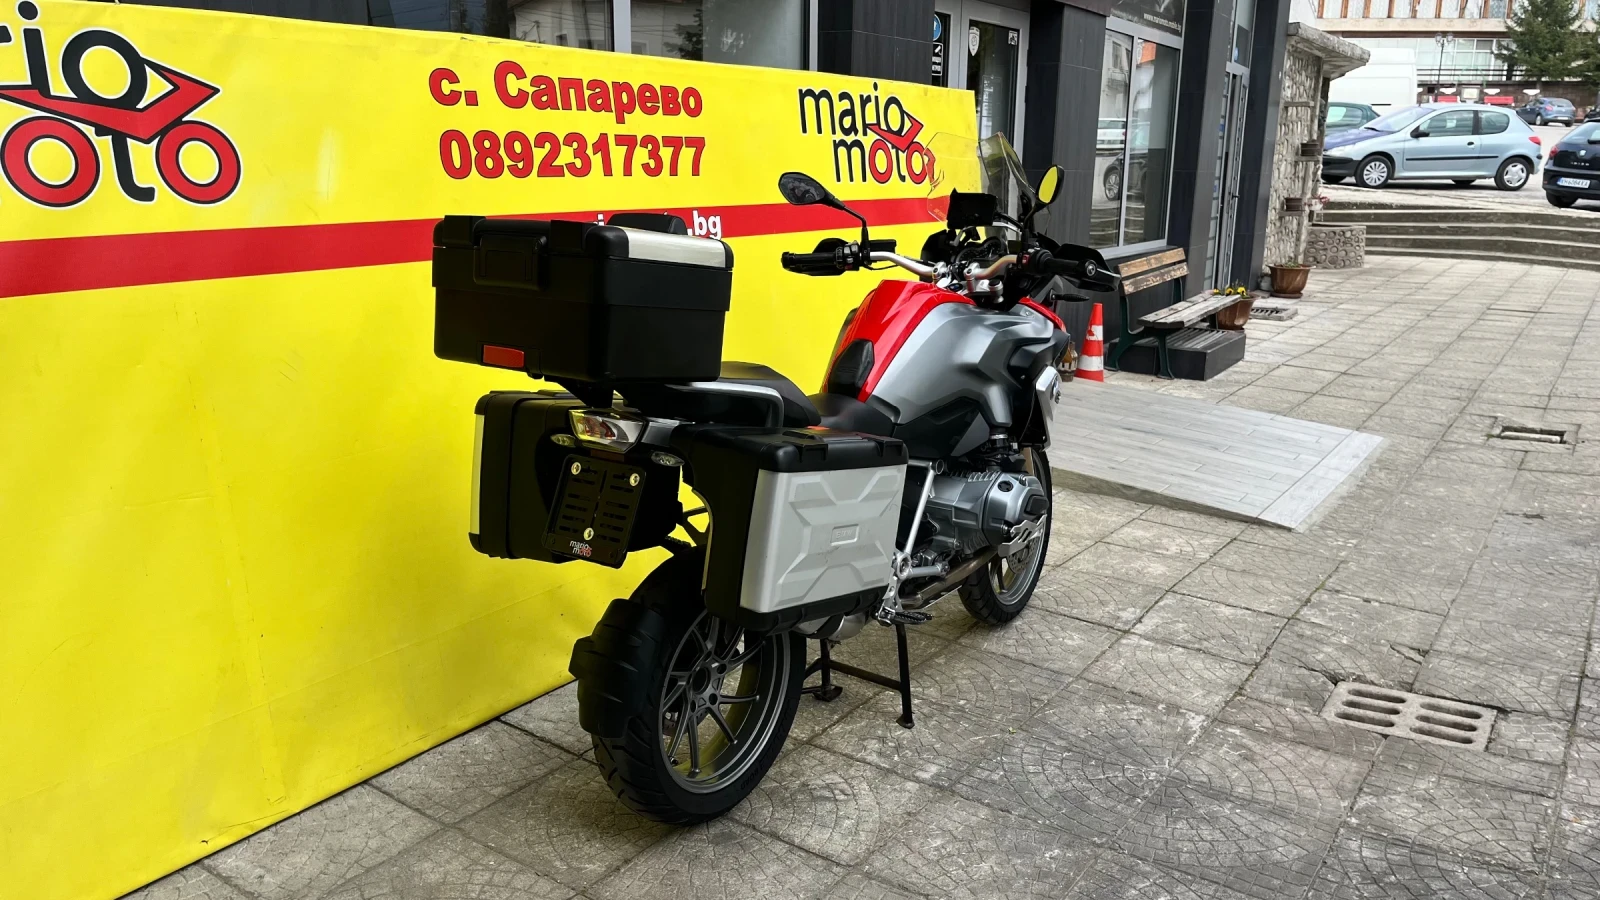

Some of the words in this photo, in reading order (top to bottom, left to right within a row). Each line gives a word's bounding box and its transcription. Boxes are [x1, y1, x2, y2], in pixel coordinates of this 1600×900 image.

[428, 68, 478, 106] с.
[493, 61, 703, 124] Сапарево
[798, 82, 905, 137] mario
[439, 129, 706, 180] 0892317377
[832, 139, 928, 184] moto
